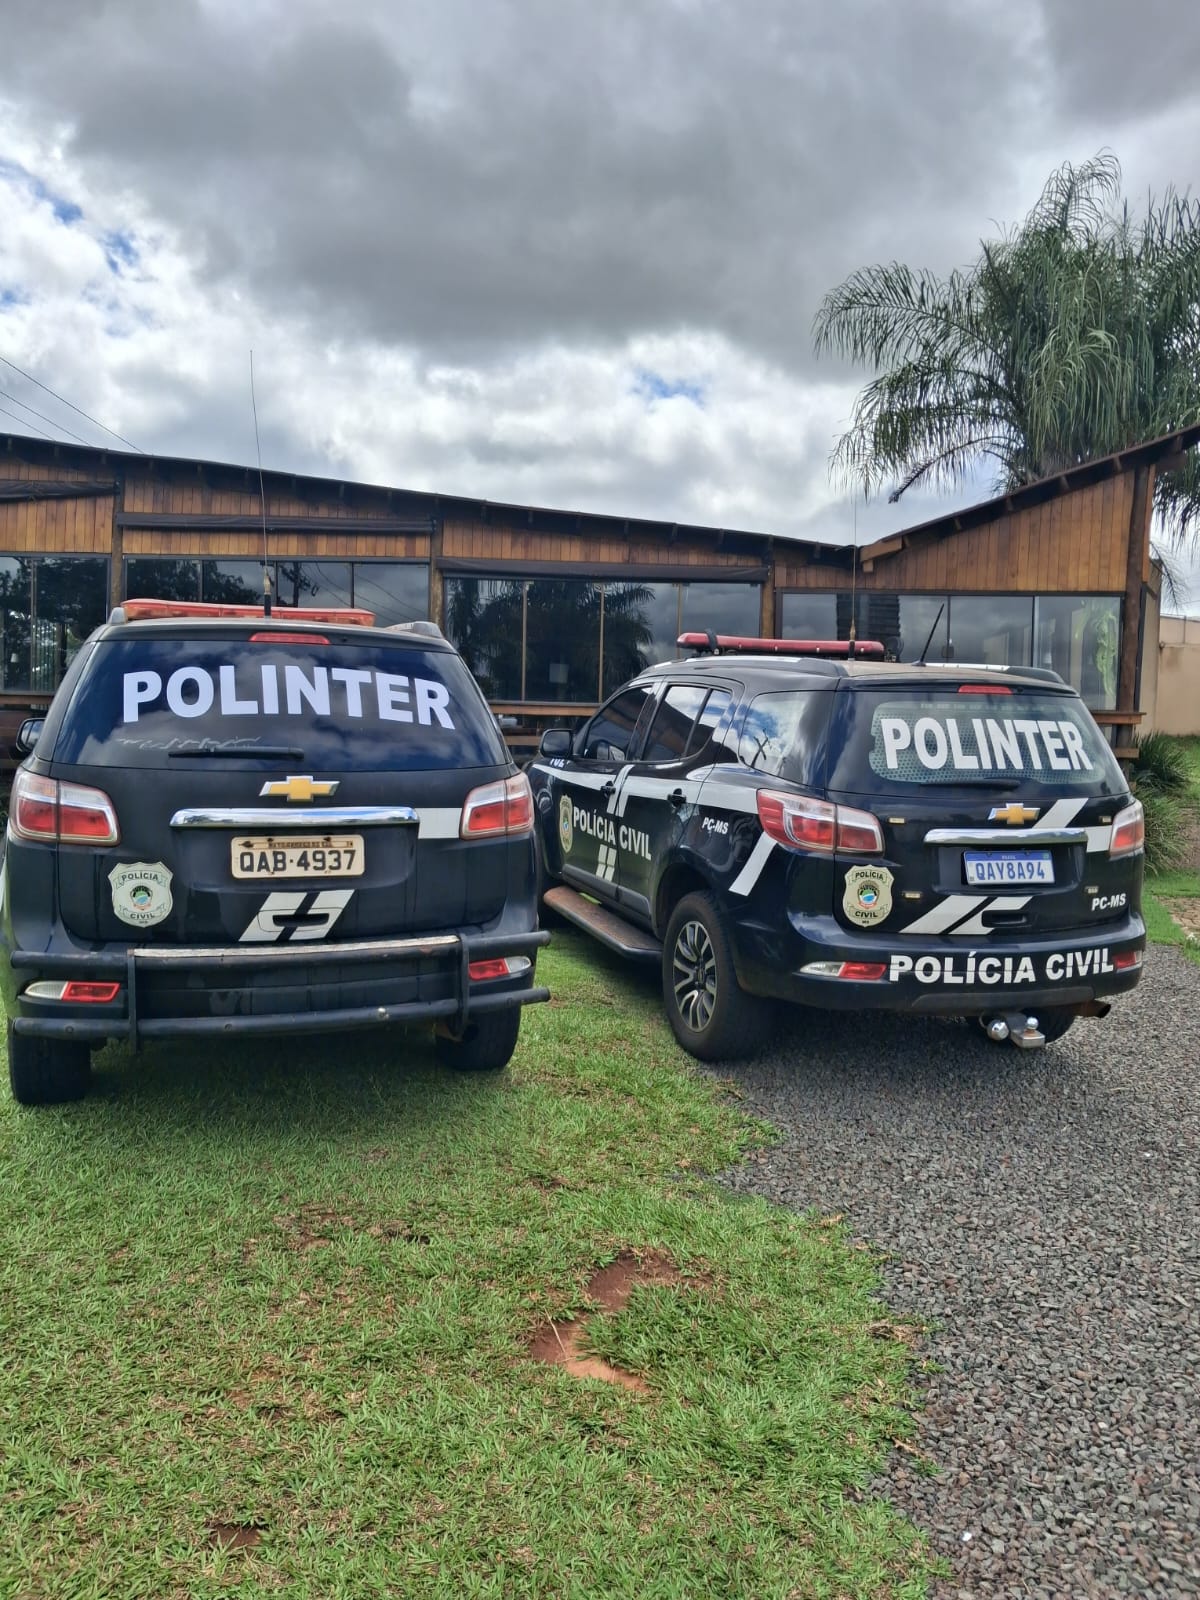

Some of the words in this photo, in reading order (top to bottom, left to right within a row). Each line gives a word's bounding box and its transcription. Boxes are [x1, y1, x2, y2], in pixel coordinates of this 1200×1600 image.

[123, 664, 455, 729] POLINTER
[881, 717, 1093, 771] POLINTER
[573, 806, 617, 845] POLÍCIA
[619, 825, 652, 861] CIVIL
[701, 816, 729, 835] PC-MS
[975, 862, 1045, 881] QAY8A94
[1091, 892, 1127, 911] PC-MS
[889, 951, 1036, 984] POLÍCIA
[1045, 948, 1114, 980] CIVIL
